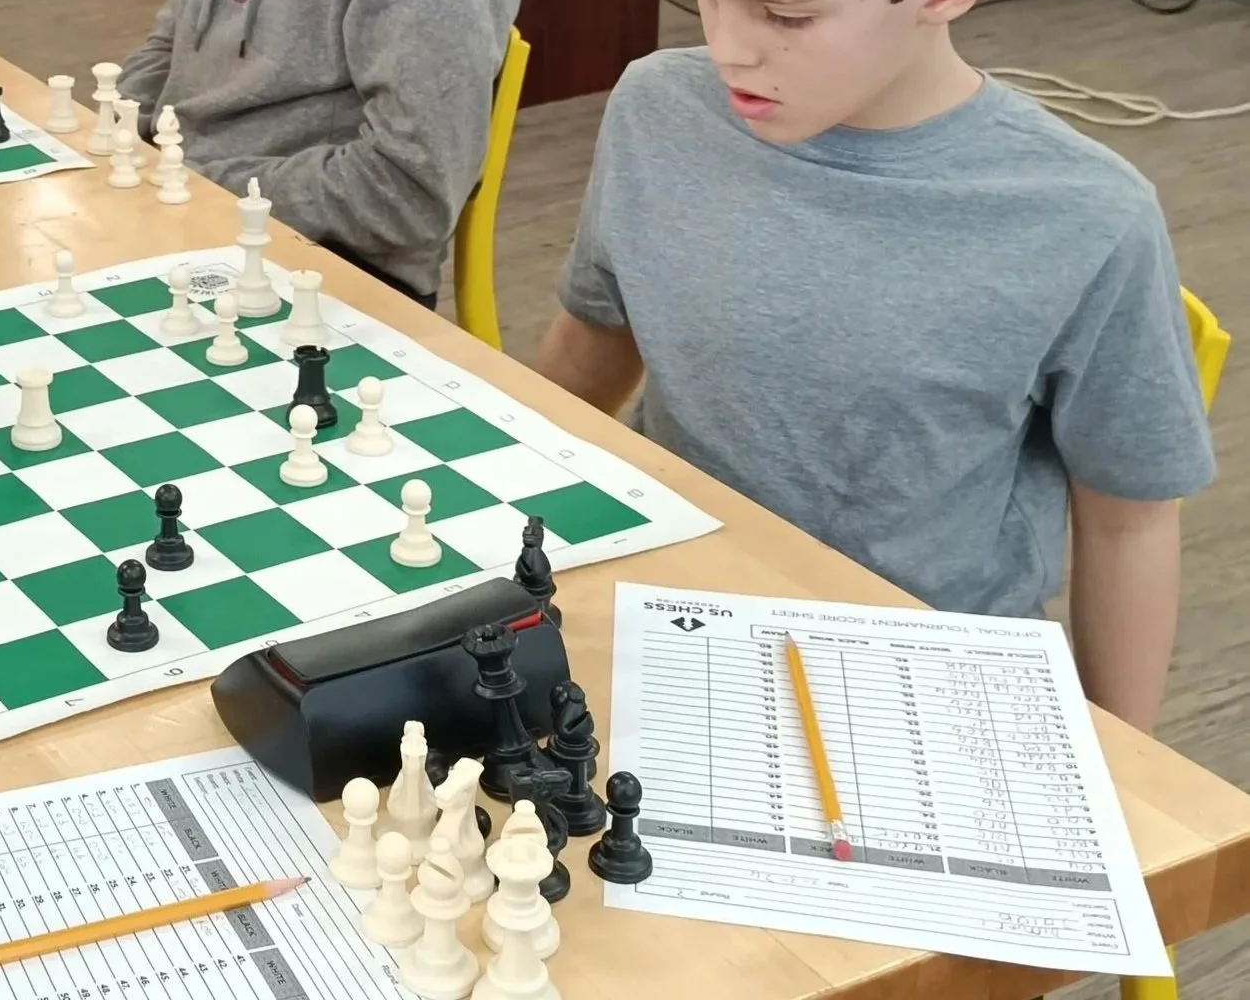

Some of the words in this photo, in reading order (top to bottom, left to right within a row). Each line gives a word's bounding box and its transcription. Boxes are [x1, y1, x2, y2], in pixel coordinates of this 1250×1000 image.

[643, 602, 703, 614] CHESS
[709, 608, 733, 618] US
[770, 610, 814, 619] SHEET
[819, 614, 866, 625] SCORE
[872, 618, 970, 633] TOURNAMENT
[975, 628, 1041, 638] OFFICIAL
[160, 789, 177, 810] WHITE
[656, 825, 694, 836] BLACK
[184, 828, 201, 850] BLACK
[732, 835, 769, 845] WHITE
[888, 856, 924, 865] WHITE
[969, 866, 1008, 876] BLACK
[1052, 876, 1089, 884] WHITE
[237, 913, 257, 937] BLACK
[267, 960, 286, 986] WHITE
